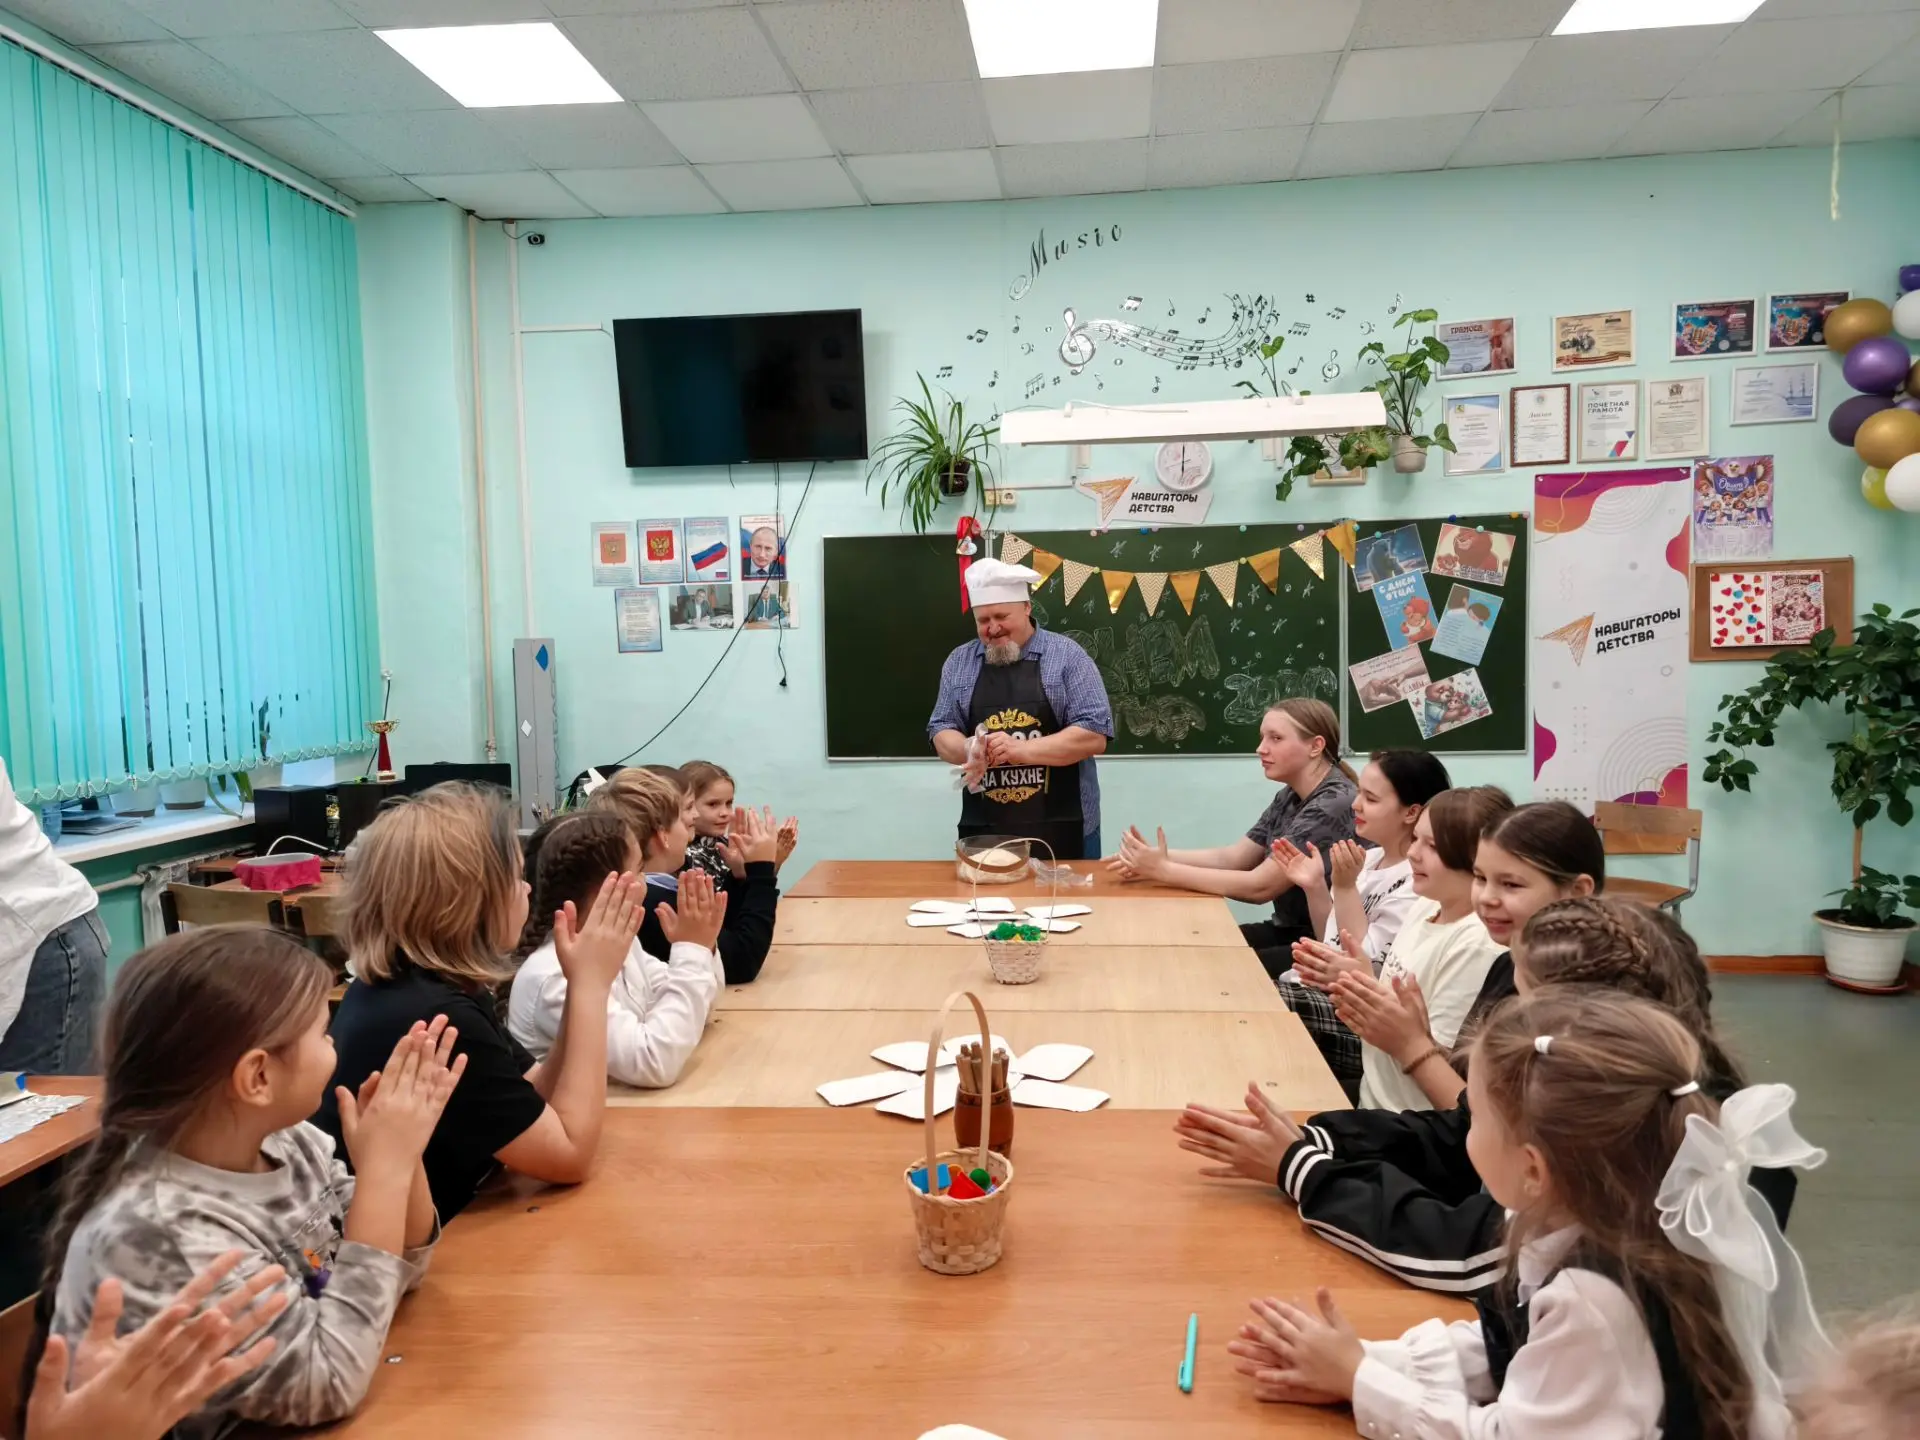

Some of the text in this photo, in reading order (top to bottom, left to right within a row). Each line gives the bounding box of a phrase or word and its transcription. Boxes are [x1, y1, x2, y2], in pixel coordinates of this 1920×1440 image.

[1009, 224, 1122, 301] Music
[1130, 491, 1198, 503] НАВИГАТОРЫ
[1128, 503, 1175, 514] ДЕТСТВА
[1378, 585, 1386, 594] С
[1594, 607, 1681, 638] НАВИГАТОРЫ
[1596, 630, 1655, 654] ДЕТСТВА
[982, 767, 1045, 788] НА КУХНЕ
